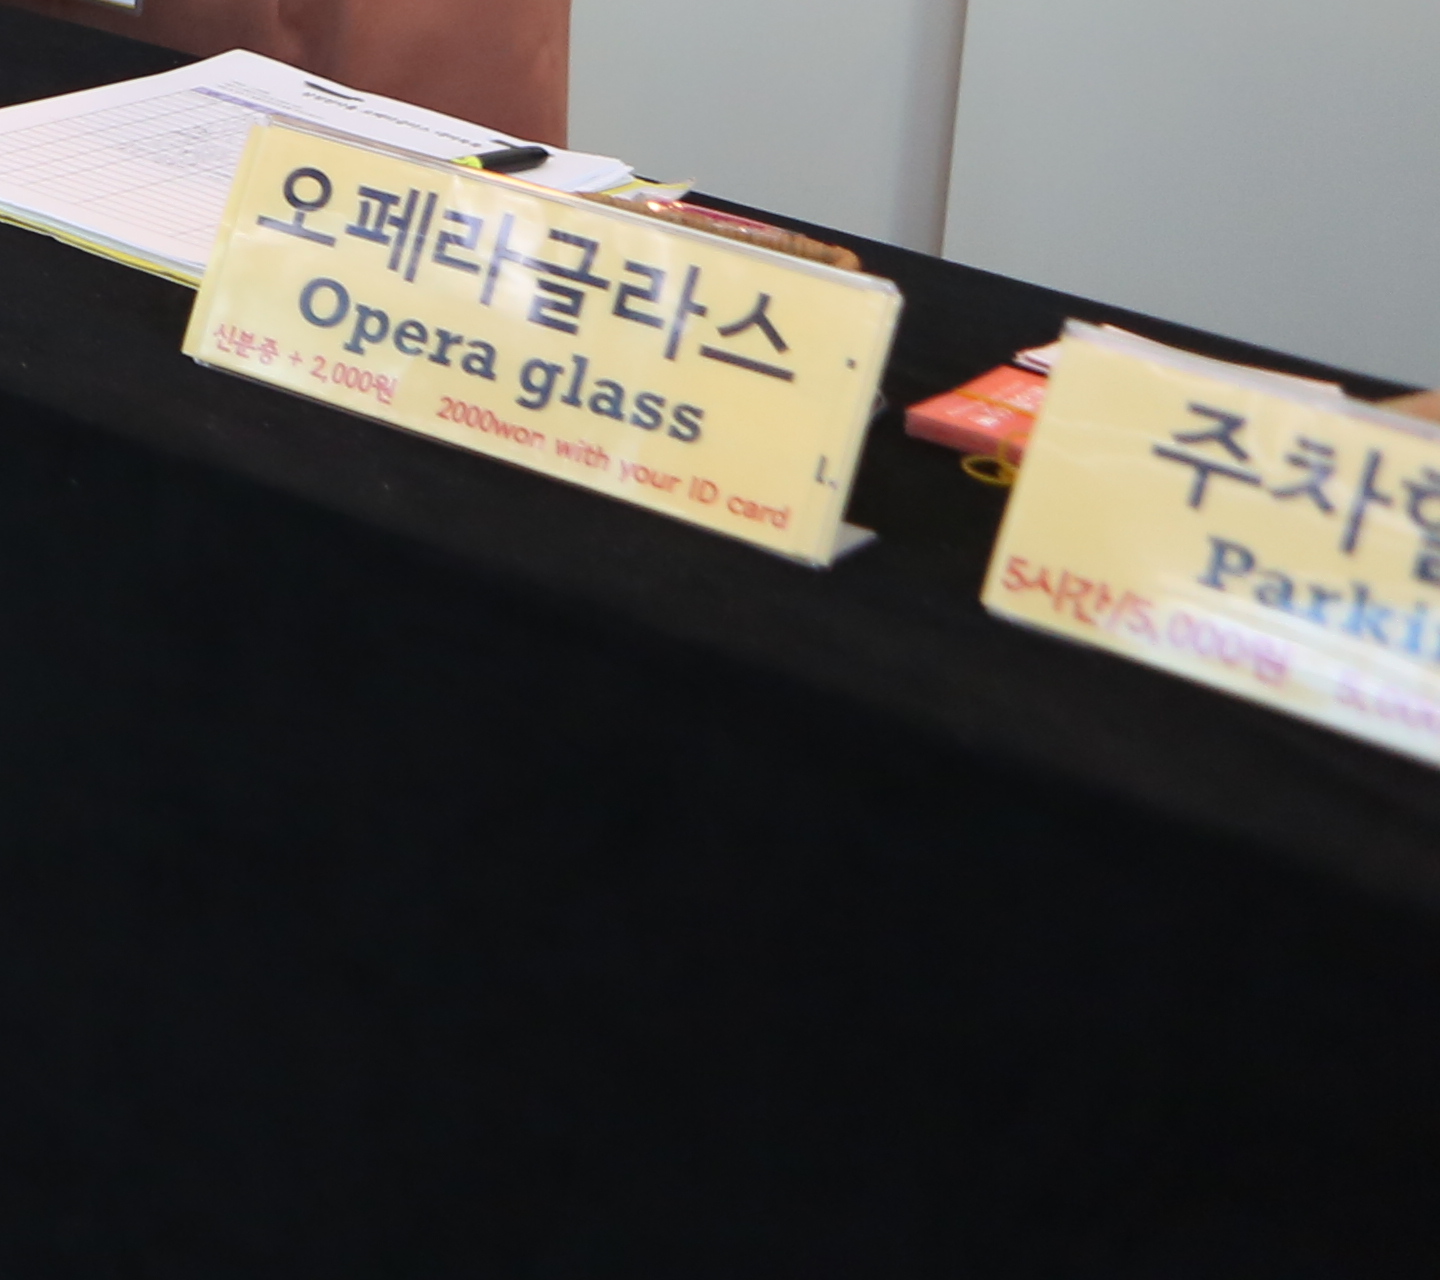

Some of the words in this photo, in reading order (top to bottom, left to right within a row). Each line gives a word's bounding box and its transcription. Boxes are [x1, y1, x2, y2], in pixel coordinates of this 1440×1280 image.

[256, 166, 795, 383] 오페라글라스
[298, 277, 497, 382] Opera
[516, 352, 705, 444] glass
[214, 323, 279, 365] 신분증
[436, 396, 546, 450] 2000won
[555, 438, 610, 472] with
[620, 458, 682, 495] your
[689, 475, 719, 505] ID
[726, 495, 792, 531] card
[1196, 534, 1440, 663] Parki
